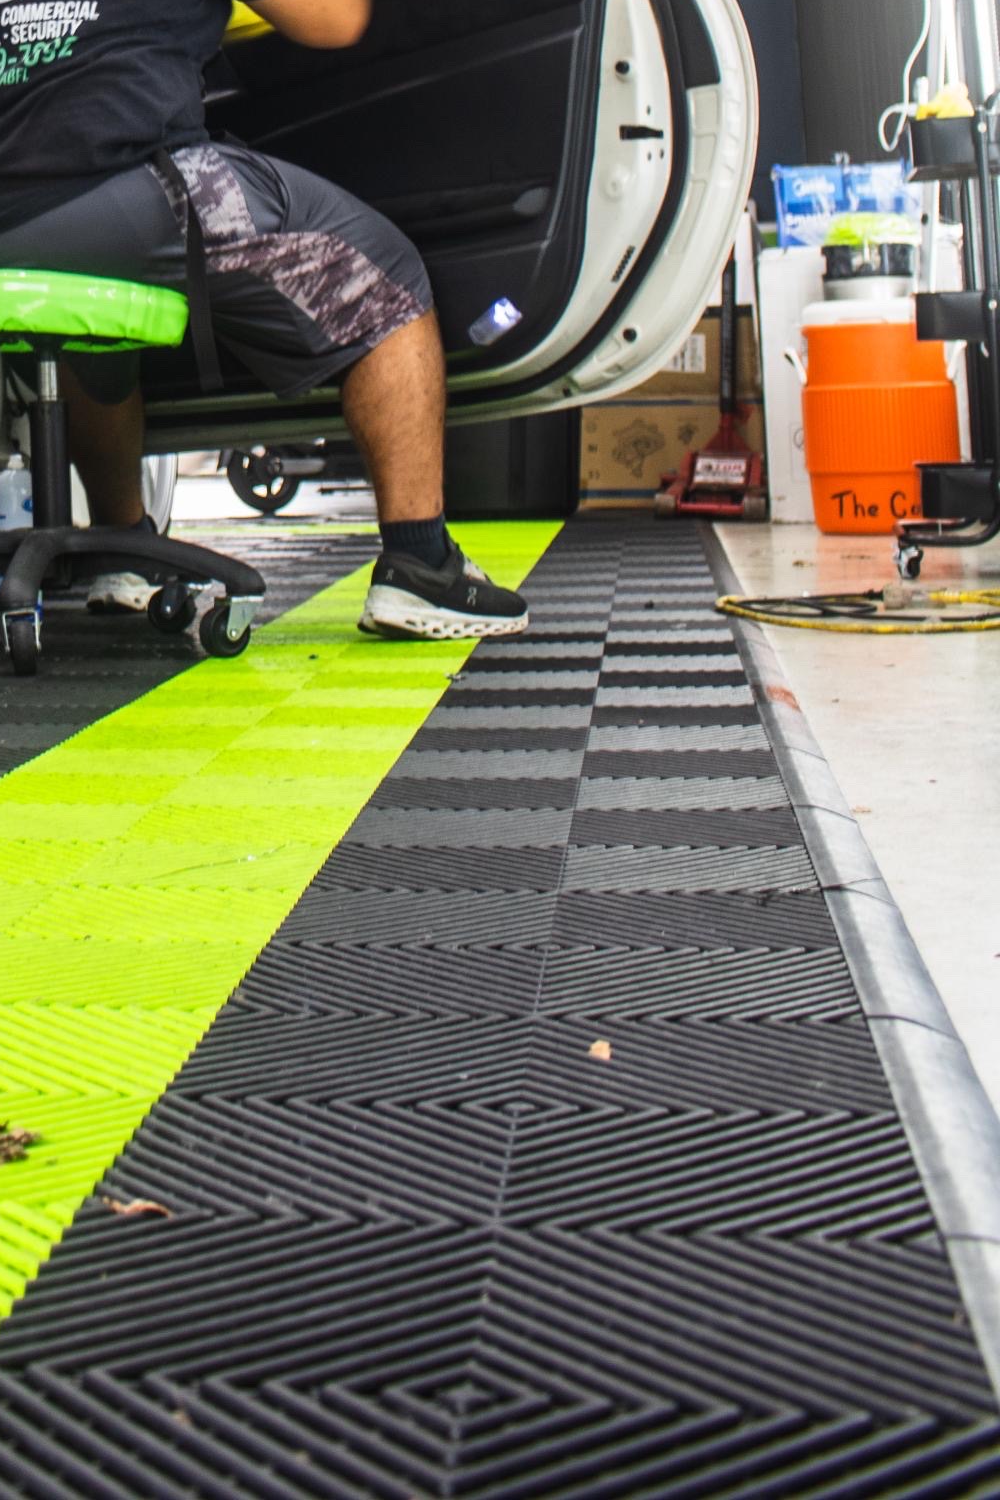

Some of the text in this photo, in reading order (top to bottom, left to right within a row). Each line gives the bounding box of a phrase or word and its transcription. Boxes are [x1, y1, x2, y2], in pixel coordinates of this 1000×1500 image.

[0, 0, 100, 26] COMMERCIAL
[10, 19, 84, 45] SECURITY
[831, 490, 880, 519] The
